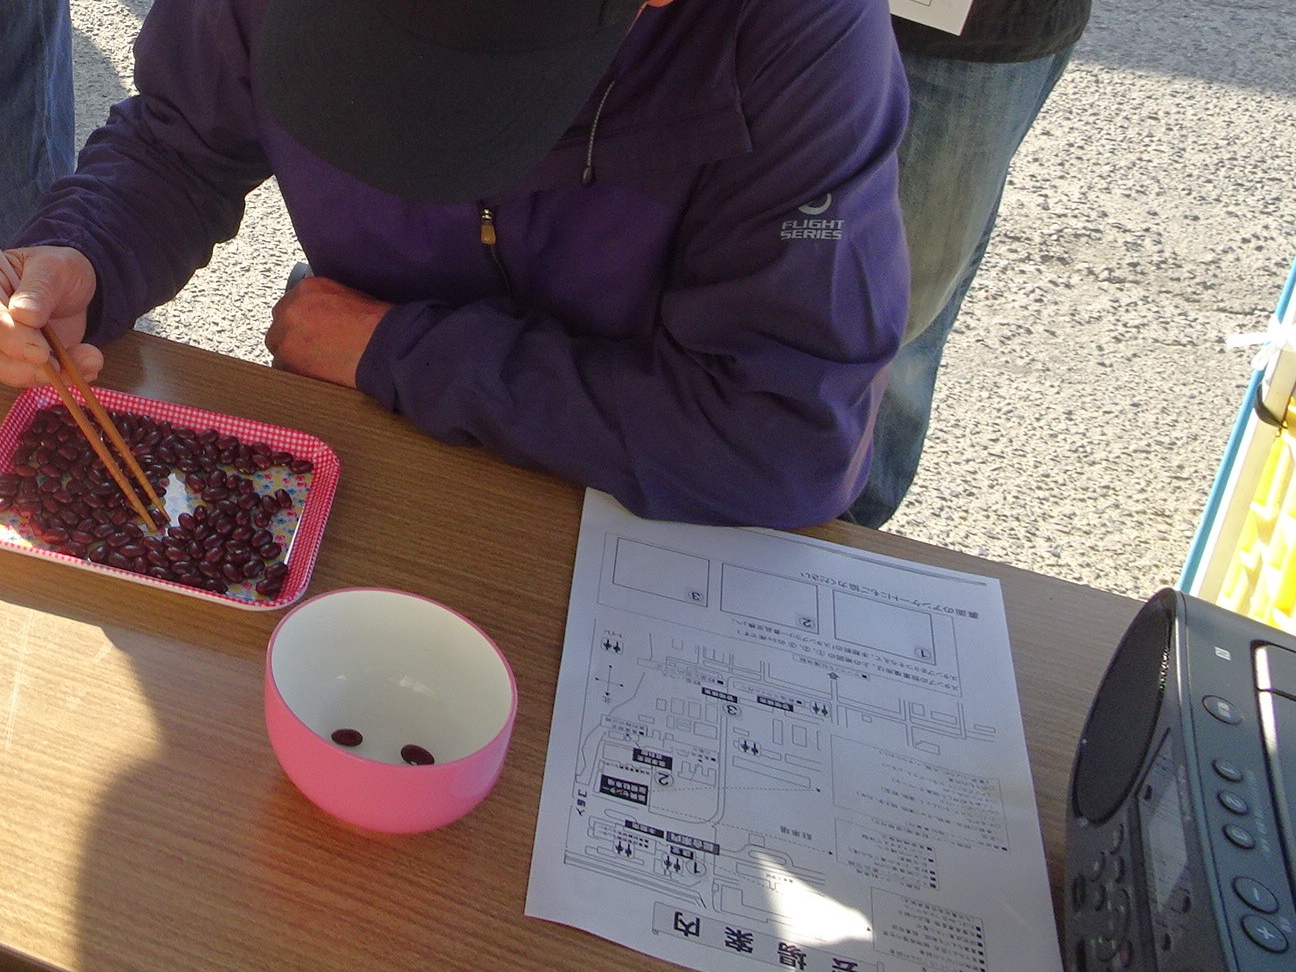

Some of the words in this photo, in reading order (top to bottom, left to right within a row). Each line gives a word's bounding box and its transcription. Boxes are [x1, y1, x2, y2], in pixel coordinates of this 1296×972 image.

[781, 219, 844, 230] FLIGHT
[780, 229, 843, 241] SERIES
[673, 910, 859, 972] 会場案内
